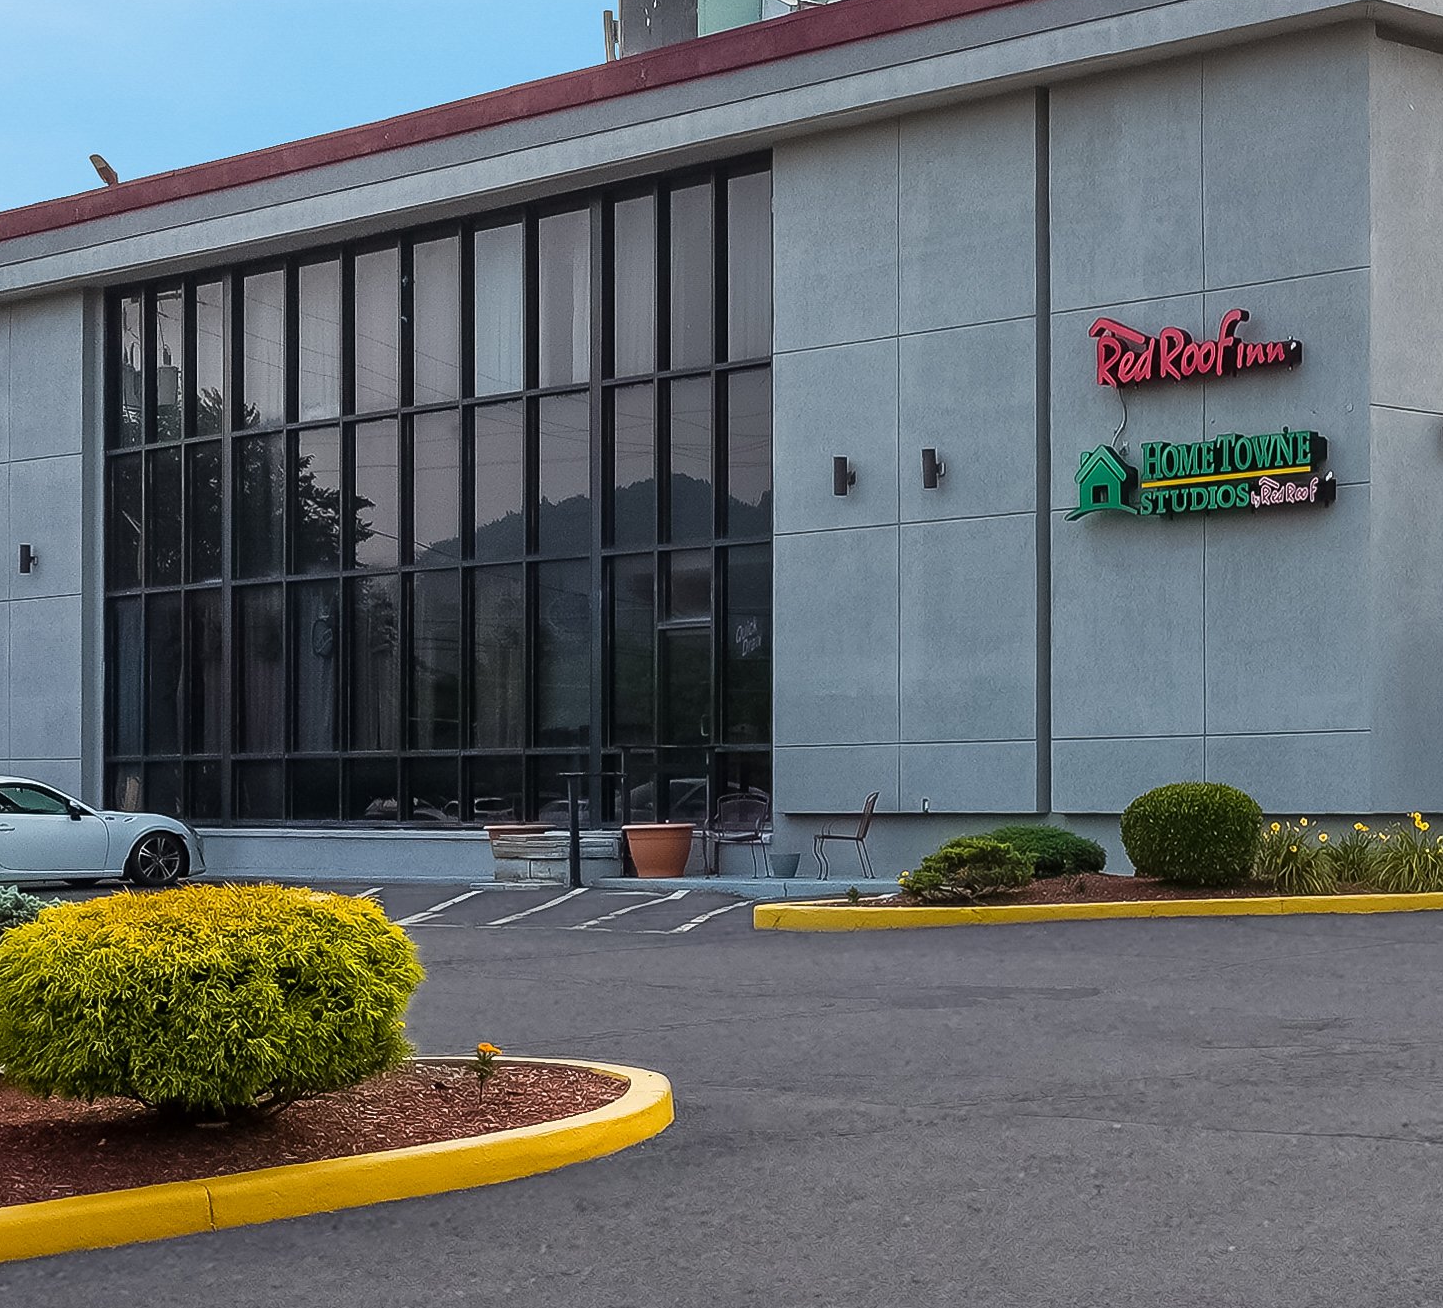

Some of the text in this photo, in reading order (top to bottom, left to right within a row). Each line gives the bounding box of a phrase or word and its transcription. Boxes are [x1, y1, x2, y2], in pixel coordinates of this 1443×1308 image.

[1097, 334, 1155, 389] Red
[1159, 309, 1242, 381] Roof
[1140, 483, 1249, 515] STUDIOS
[1261, 484, 1285, 505] Red
[1286, 476, 1319, 503] Roof
